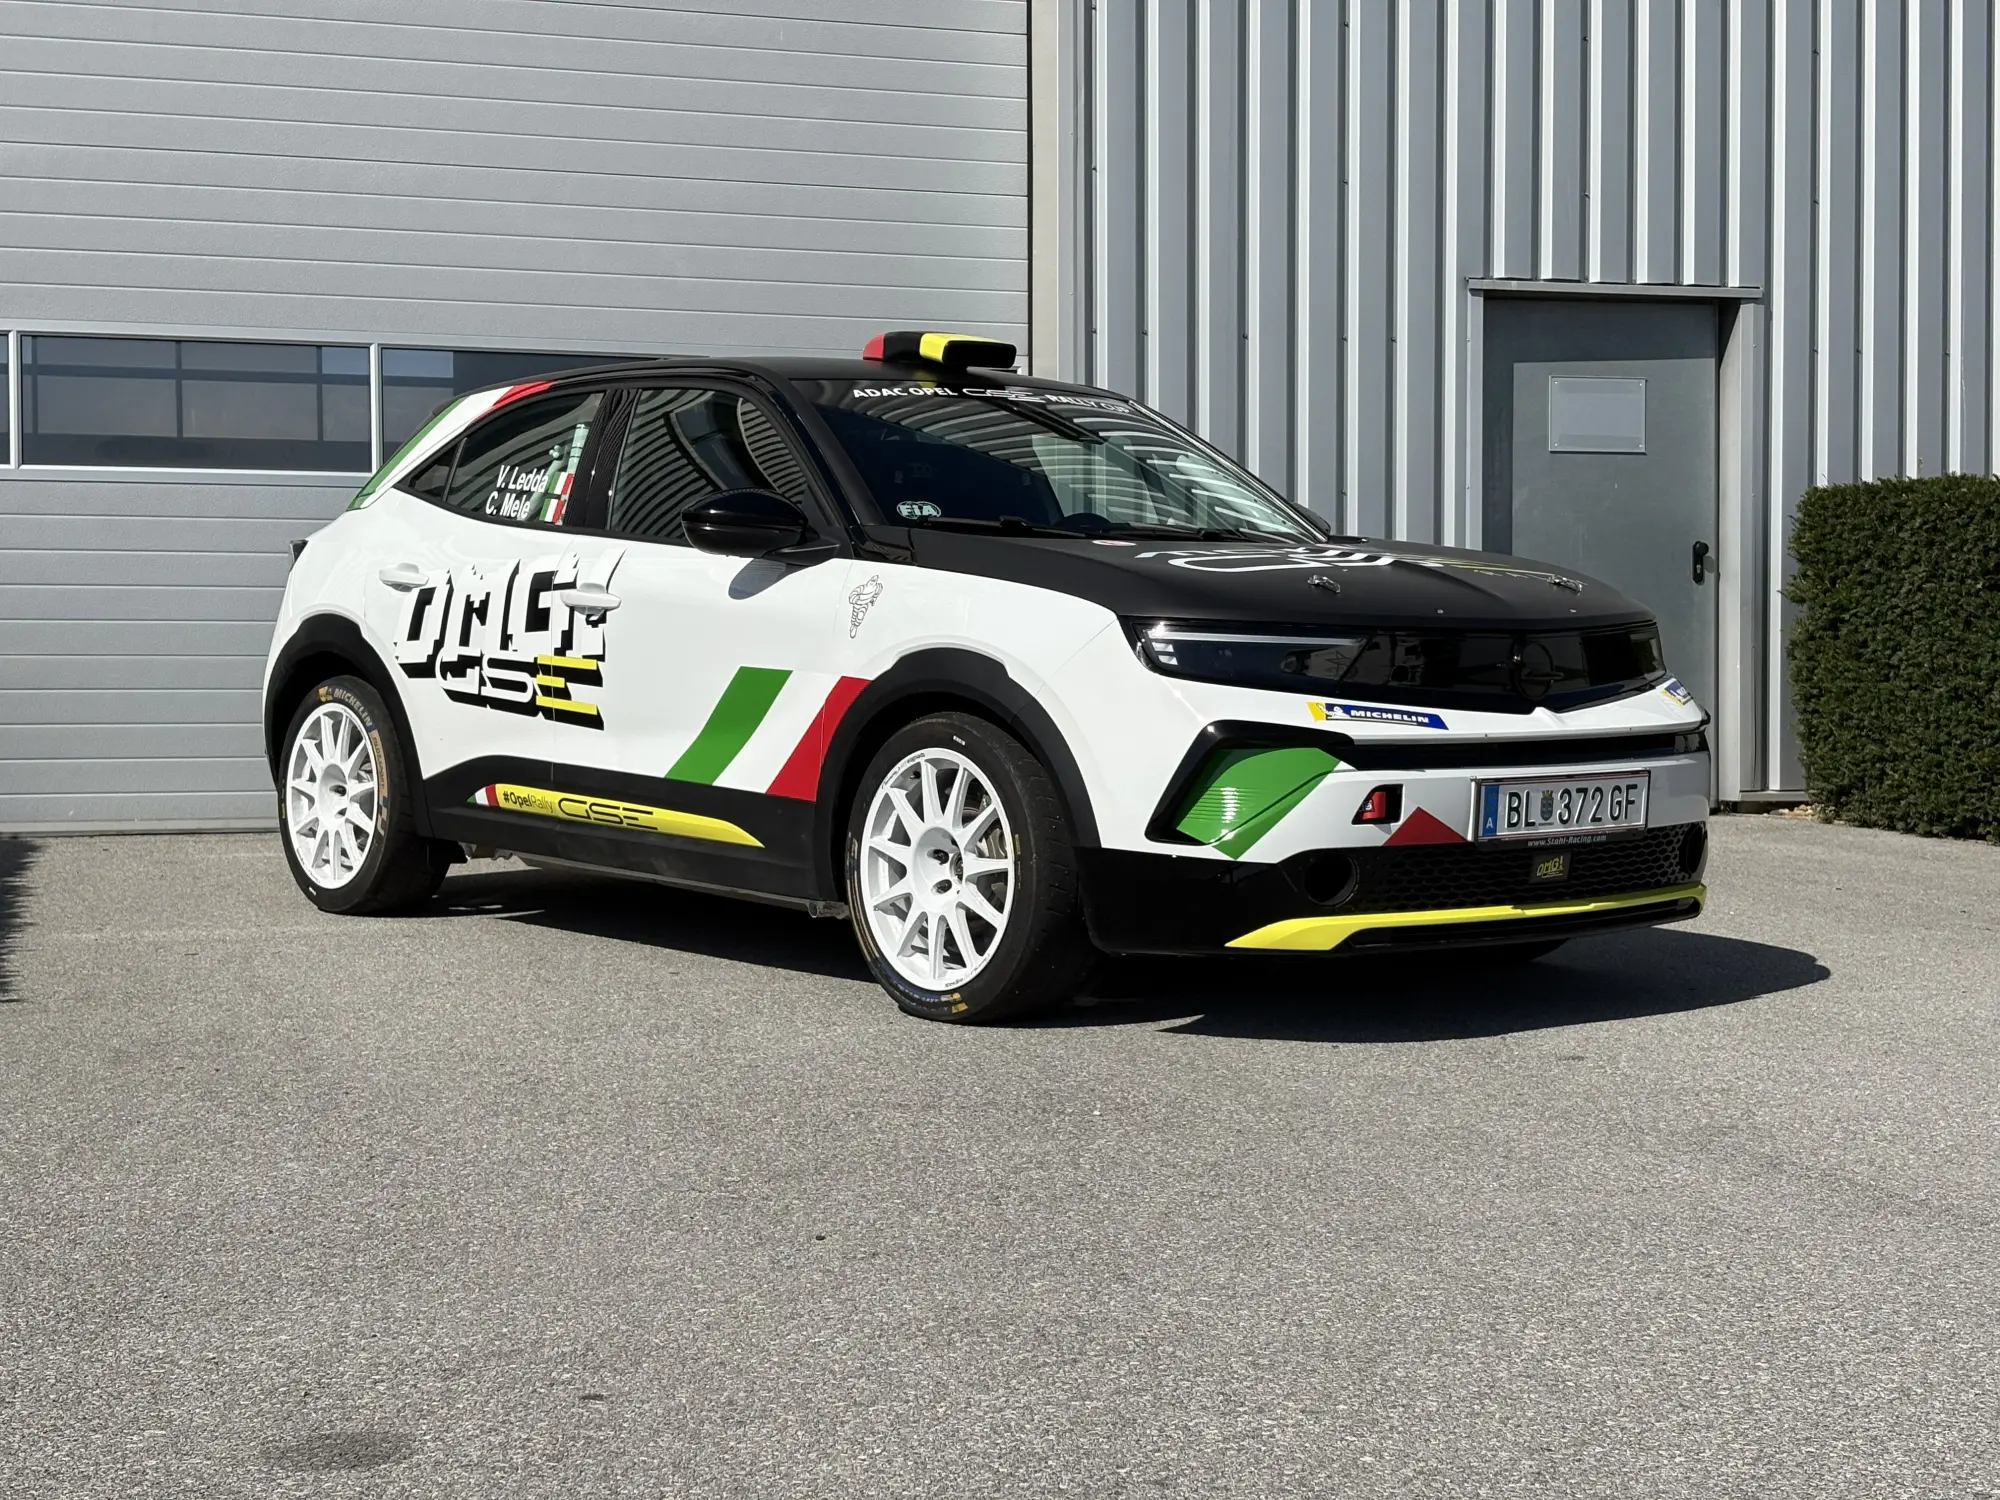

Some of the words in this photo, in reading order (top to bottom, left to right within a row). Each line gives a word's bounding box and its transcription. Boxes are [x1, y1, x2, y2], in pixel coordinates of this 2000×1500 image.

[853, 387, 908, 398] ADAC
[908, 387, 958, 396] OPEL
[1044, 394, 1098, 408] RALLY
[496, 465, 511, 489] V.
[508, 466, 549, 493] Ledda
[485, 491, 499, 515] C.
[500, 493, 531, 520] Mele
[333, 687, 374, 727] MICHELIN
[1350, 709, 1430, 723] MICHELIN
[502, 790, 554, 814] #OpelRally
[558, 797, 658, 831] GSE
[1485, 817, 1494, 829] A
[1505, 789, 1536, 829] BL
[1536, 855, 1565, 877] OMG!
